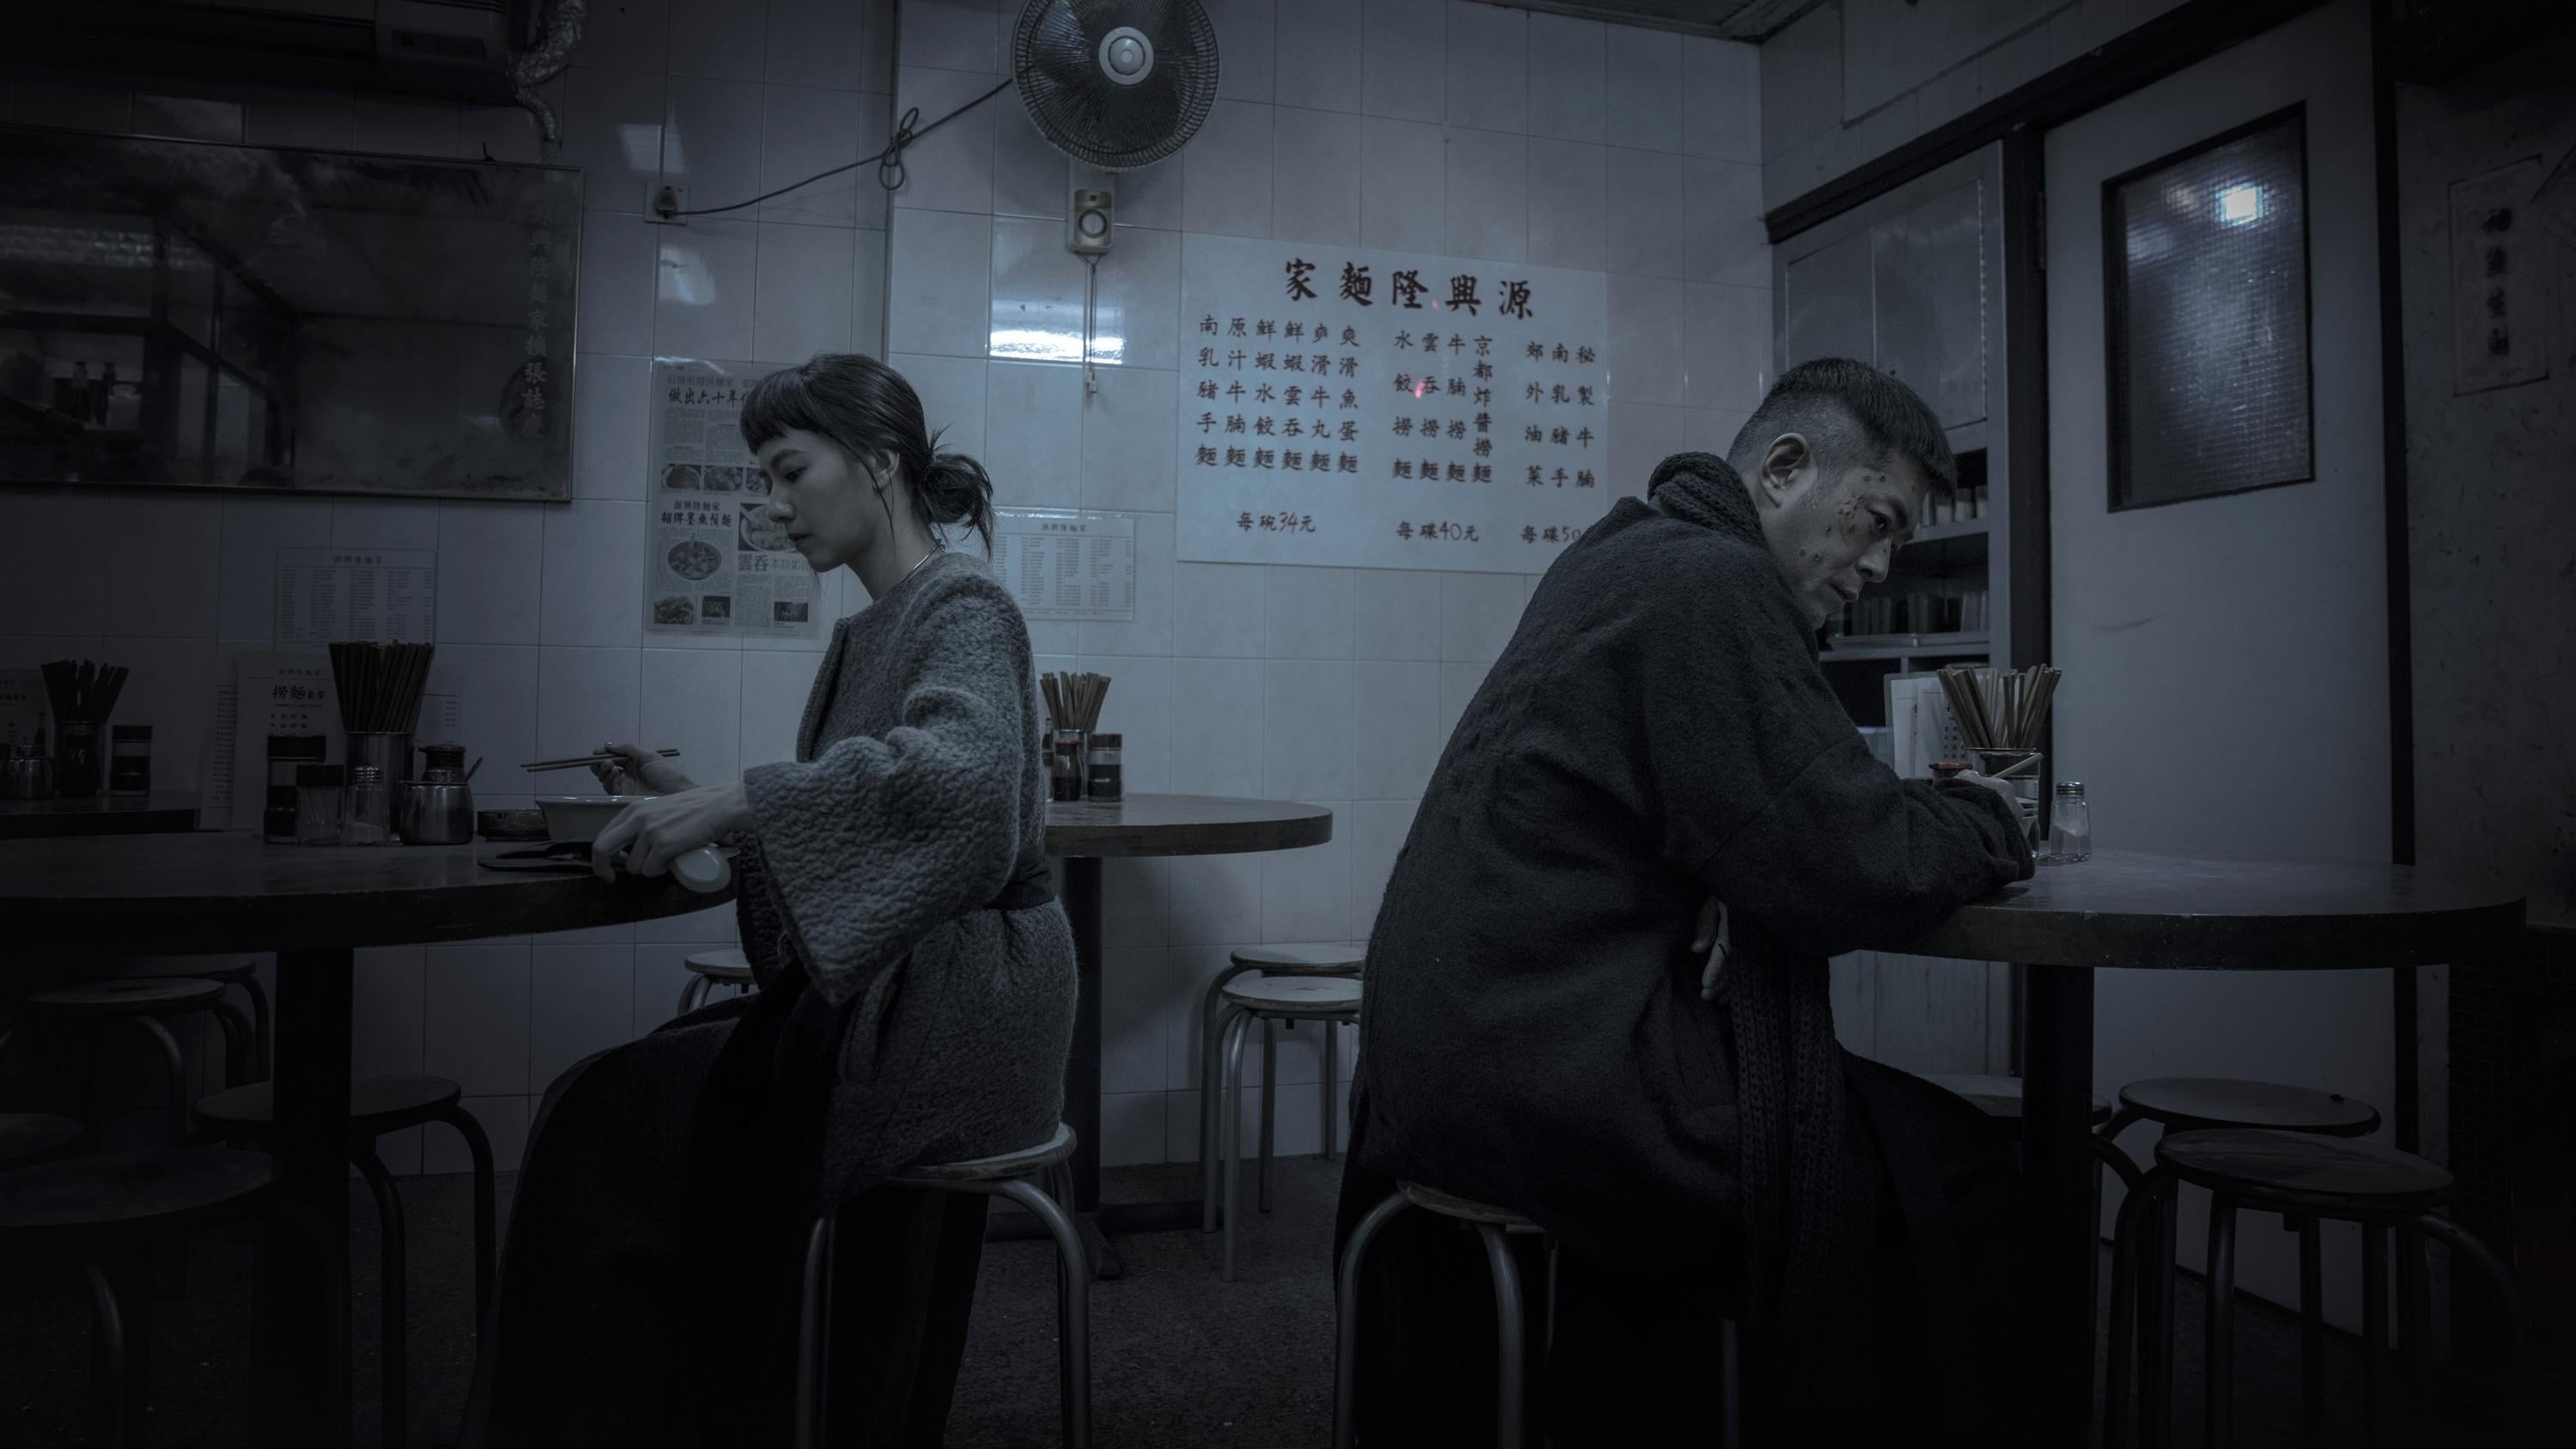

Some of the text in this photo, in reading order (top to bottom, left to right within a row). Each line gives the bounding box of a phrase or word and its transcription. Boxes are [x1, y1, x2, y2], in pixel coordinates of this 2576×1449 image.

[1284, 258, 1534, 321] 源興隆麵家
[1195, 314, 1219, 466] 南乳豬手麵
[1224, 317, 1247, 467] 原汁牛腩麵
[1253, 318, 1277, 469] 鮮蝦水餃麵
[1281, 320, 1305, 471] 鮮蝦雲吞麵
[1309, 322, 1332, 472] 爽滑牛丸麵
[1337, 325, 1360, 473] 爽滑魚蛋麵
[1392, 330, 1415, 479] 水餃撈麵
[1419, 332, 1442, 481] 雲吞撈麵
[1446, 333, 1467, 483] 牛腩撈麵
[1471, 335, 1493, 484] 京都炸醬撈麵
[1525, 340, 1545, 487] 郊外油菜
[1550, 343, 1571, 489] 南乳豬手
[1575, 345, 1596, 489] 秘製牛腩
[1236, 511, 1315, 534] 每碗34元
[1395, 521, 1479, 543] 每碟40元
[1520, 525, 1589, 545] 每碟50
